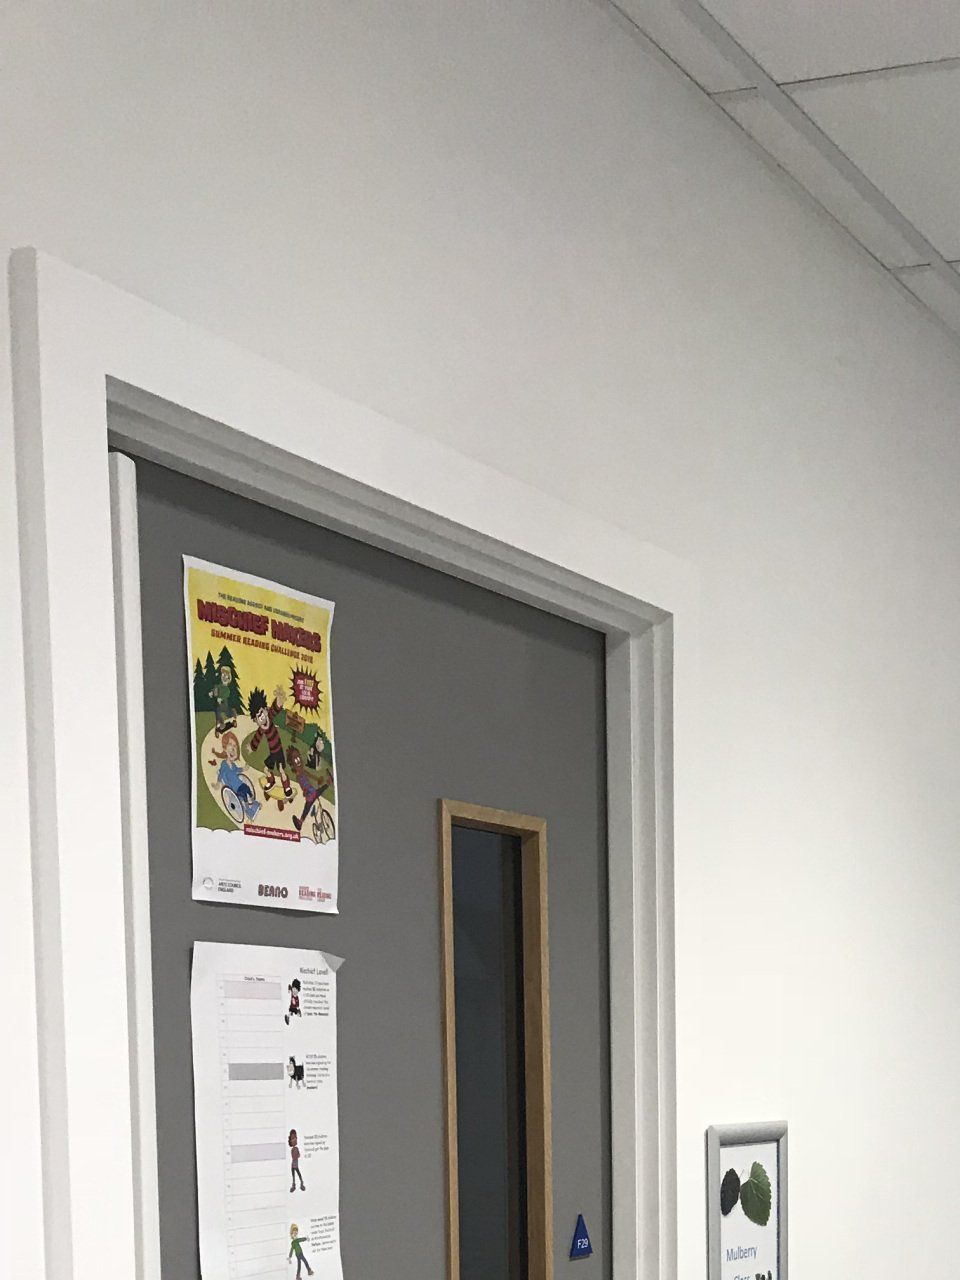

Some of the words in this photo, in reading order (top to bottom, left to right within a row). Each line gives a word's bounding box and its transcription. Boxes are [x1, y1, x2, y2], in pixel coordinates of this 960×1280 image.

[197, 599, 269, 636] MISCHIEF
[271, 619, 322, 653] MAKERS
[211, 628, 241, 643] SUMMER
[243, 636, 270, 651] READING
[271, 643, 300, 659] CHALLENGE
[258, 884, 288, 899] BEANO
[726, 1246, 758, 1262] Mulberry
